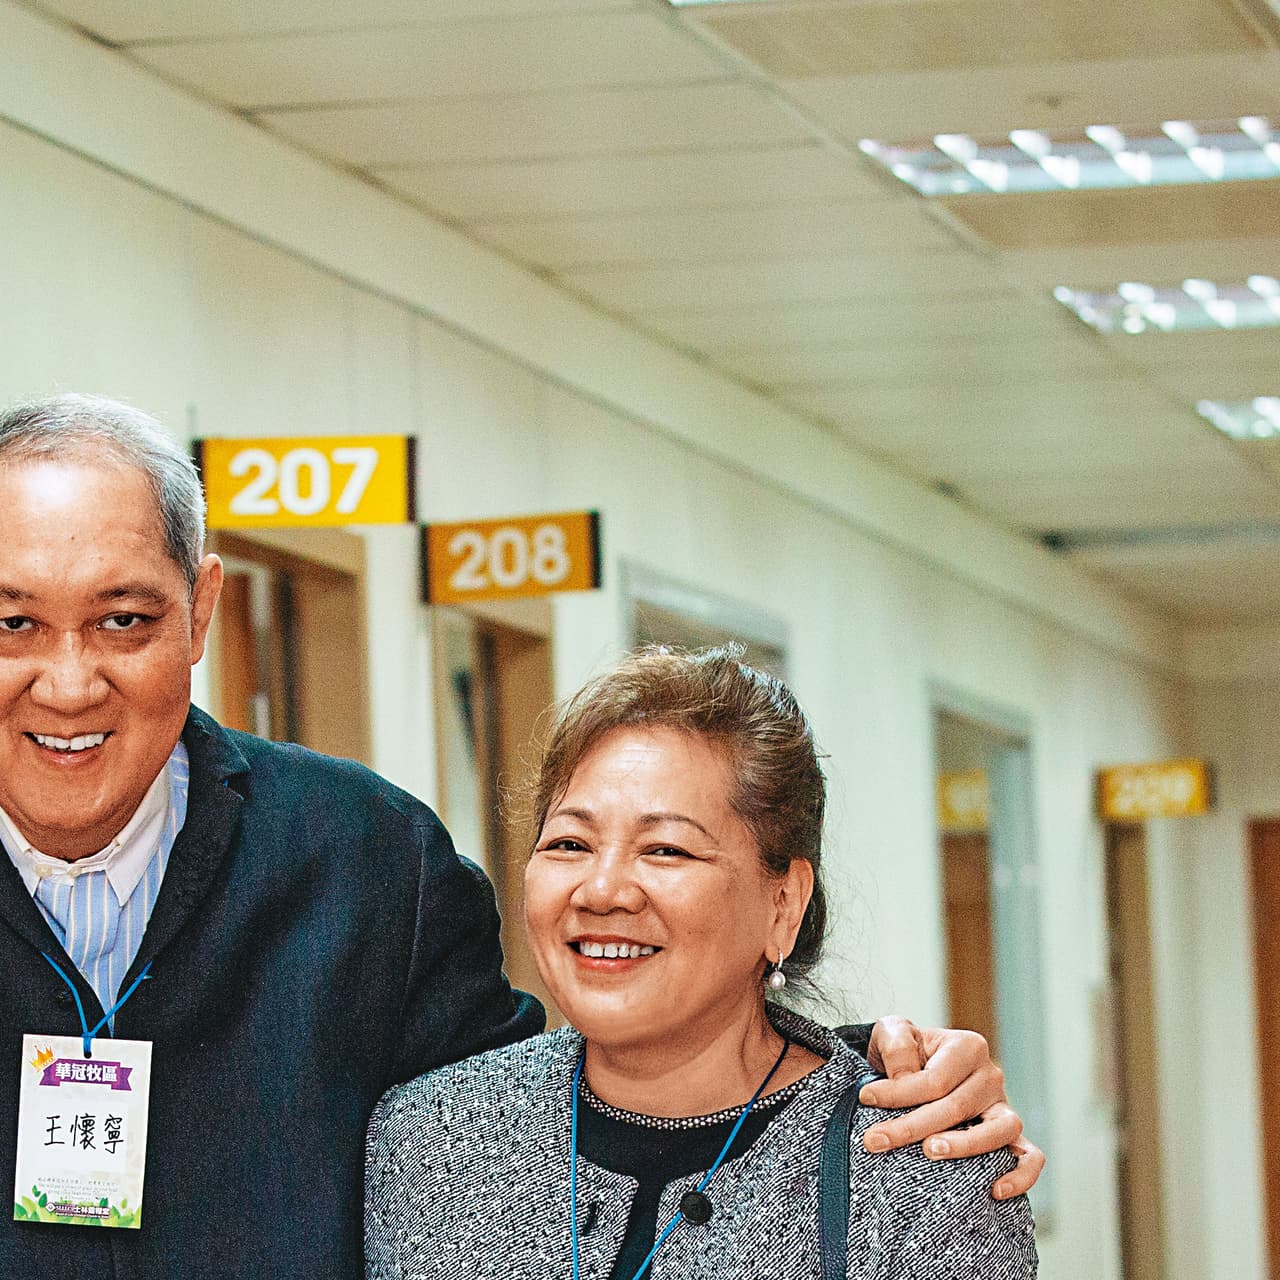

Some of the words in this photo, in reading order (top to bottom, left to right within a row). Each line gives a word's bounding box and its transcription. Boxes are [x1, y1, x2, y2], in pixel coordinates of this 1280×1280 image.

[228, 447, 379, 515] 207
[449, 524, 571, 592] 208
[55, 1062, 118, 1083] 華冠牧區
[44, 1112, 125, 1154] 王懷寧
